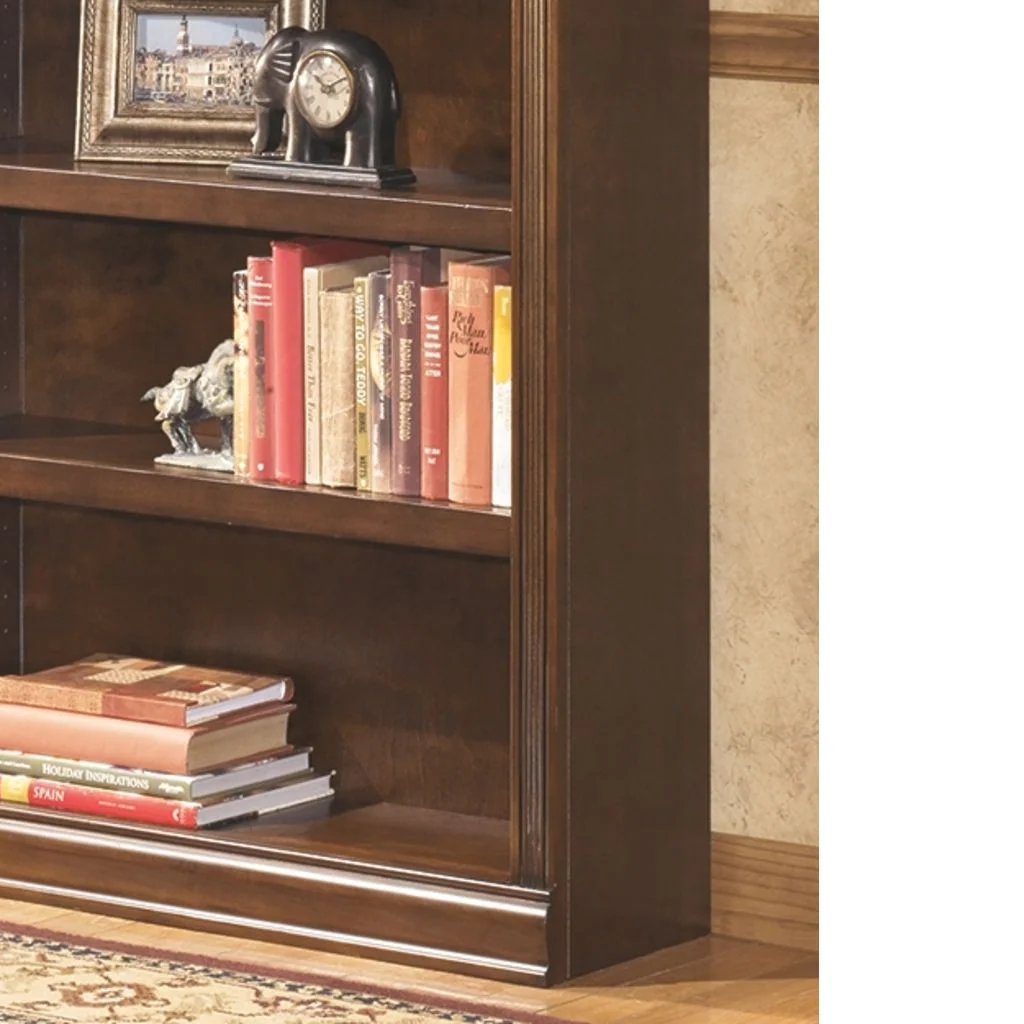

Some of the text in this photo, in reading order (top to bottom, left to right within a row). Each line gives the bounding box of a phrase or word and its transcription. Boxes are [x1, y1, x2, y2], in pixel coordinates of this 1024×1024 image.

[355, 294, 365, 322] WAY
[355, 325, 365, 341] TO
[355, 367, 367, 406] TEDDY
[358, 455, 368, 479] WATTS
[41, 763, 83, 780] HOLIDAY
[85, 770, 150, 790] INSPIRATIONS
[33, 786, 65, 802] SPAIN
